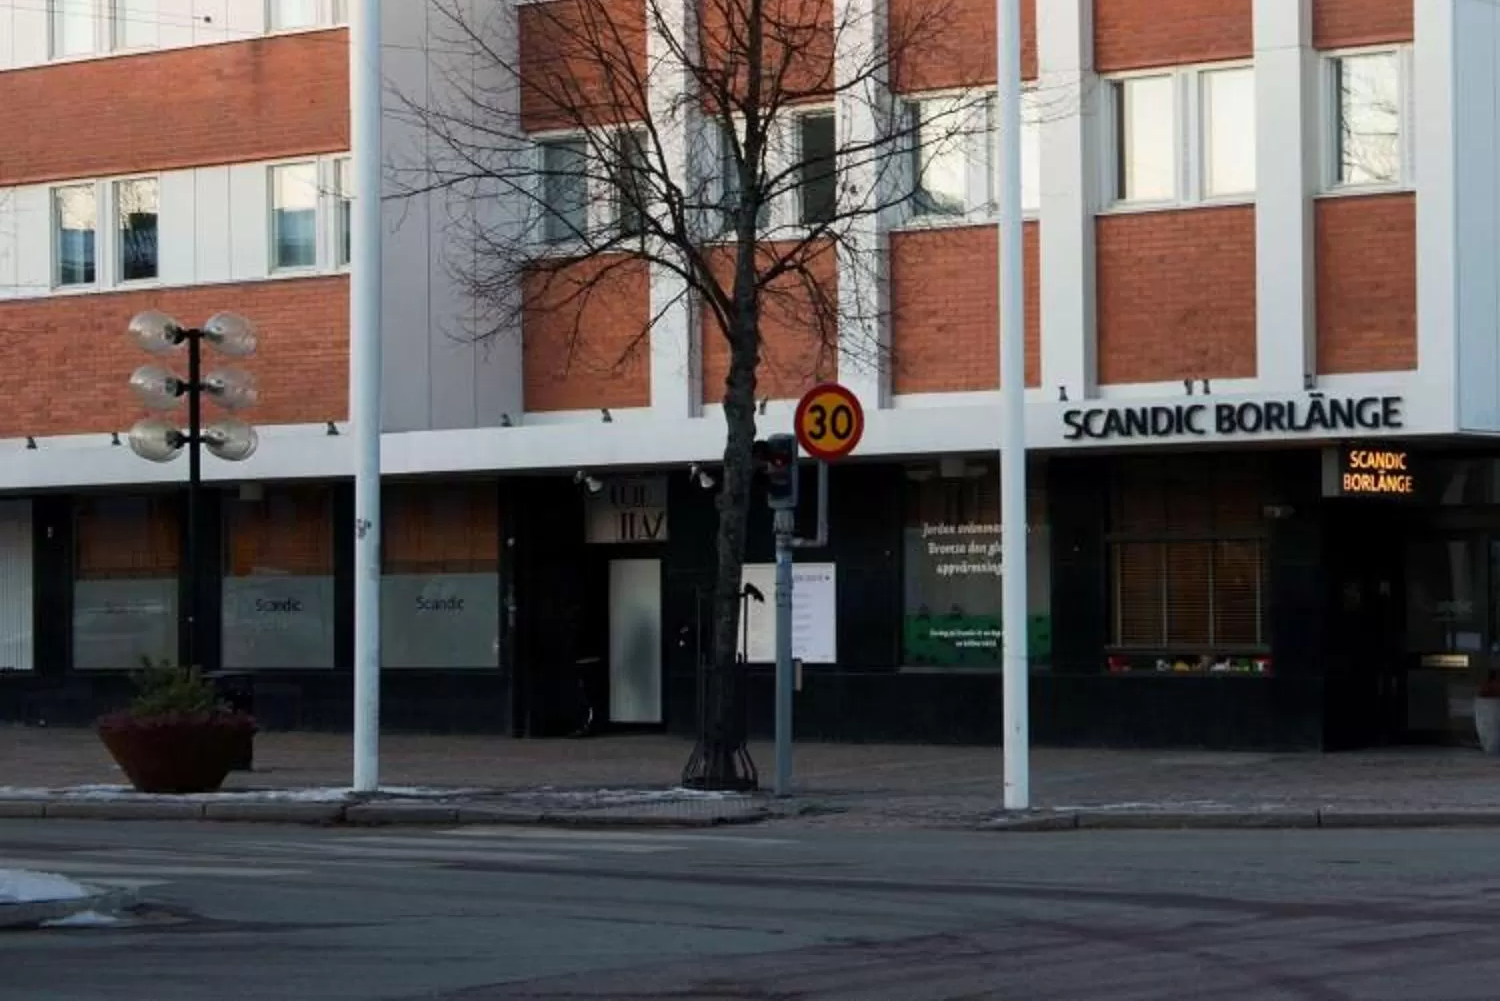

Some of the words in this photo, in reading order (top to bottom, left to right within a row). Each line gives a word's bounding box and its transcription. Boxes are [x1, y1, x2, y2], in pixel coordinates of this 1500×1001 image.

[808, 404, 853, 441] 30
[1063, 403, 1207, 440] SCANDIC
[1214, 392, 1404, 434] BORLÄNGE
[1350, 450, 1407, 471] SCANDIC
[1343, 469, 1414, 493] BORLÄNGE
[255, 598, 302, 613] Scandic
[415, 596, 464, 612] Scandic
